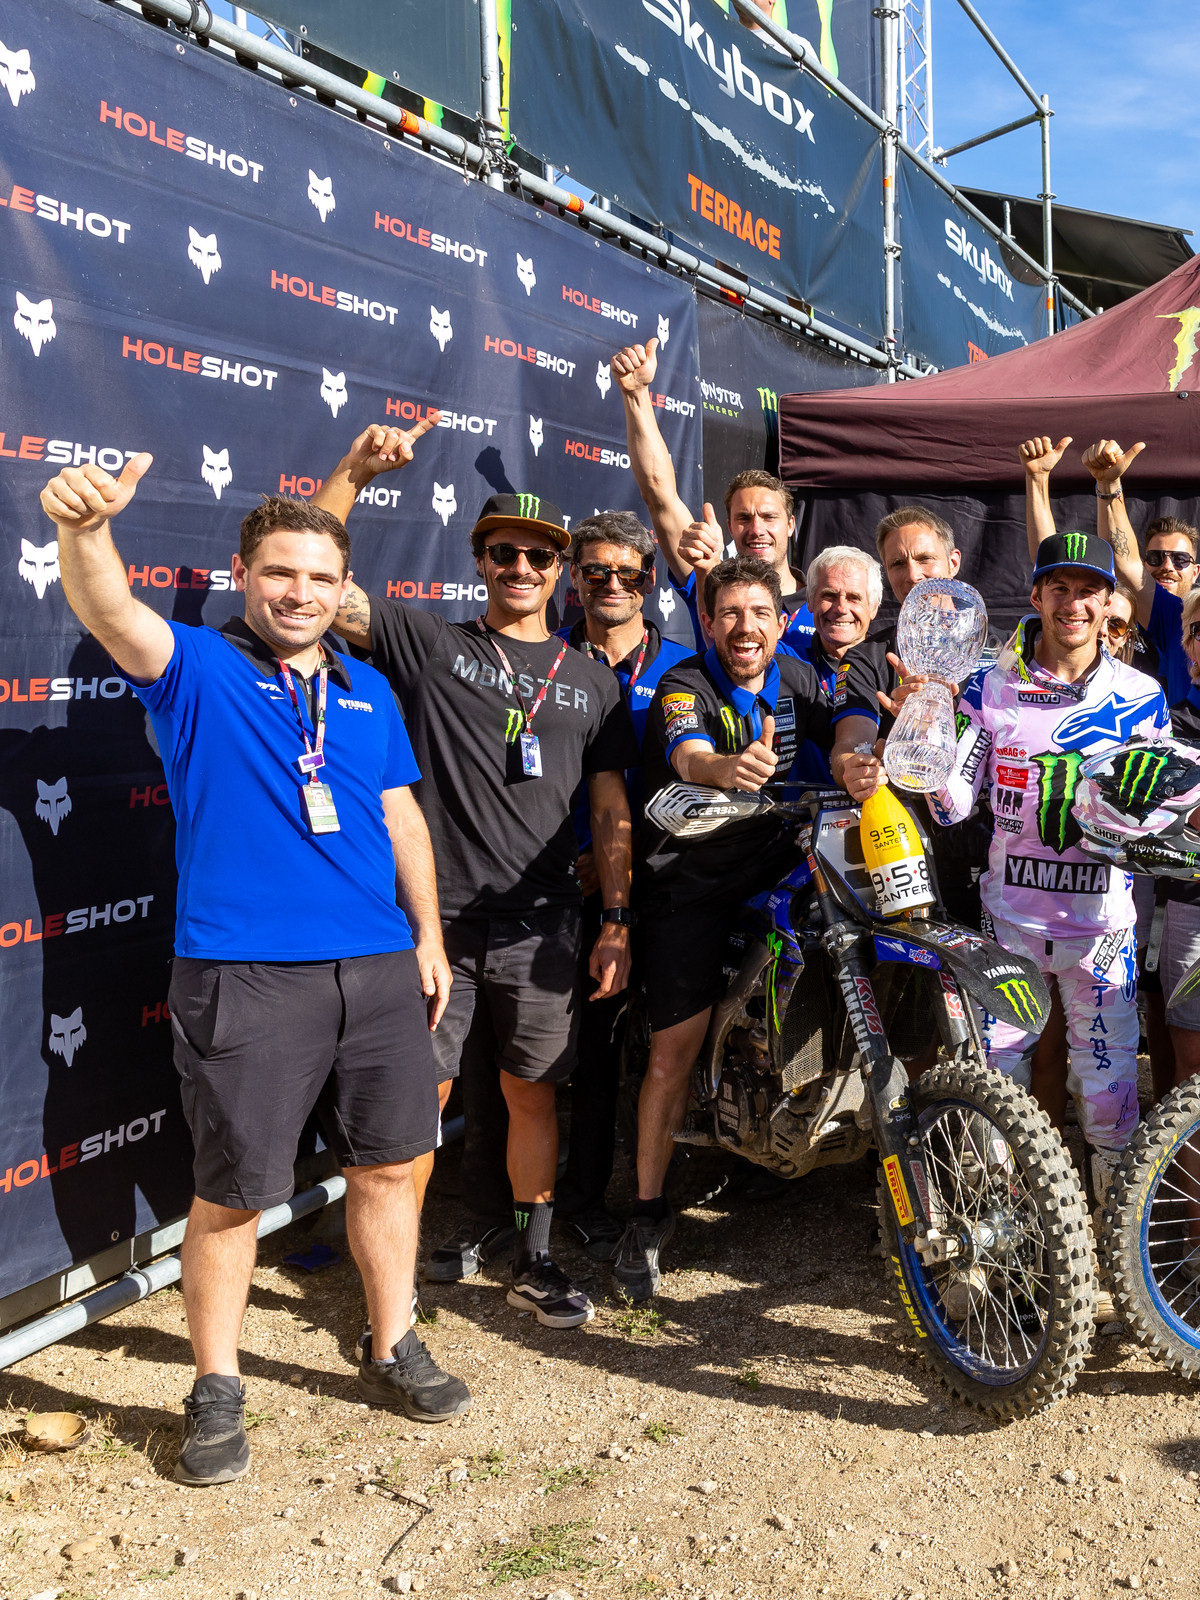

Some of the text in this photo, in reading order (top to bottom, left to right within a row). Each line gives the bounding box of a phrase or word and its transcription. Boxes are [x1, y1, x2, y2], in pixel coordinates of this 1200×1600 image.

[100, 100, 264, 183] HOLESHOT
[0, 184, 131, 244] ESHOT
[688, 173, 781, 260] TERRACE
[374, 211, 488, 267] HOLESHOT
[944, 218, 1014, 303] Skybox
[270, 269, 399, 325] HOLESHOT
[562, 285, 639, 329] HOLESHOT
[122, 336, 278, 391] HOLESHOT
[484, 335, 576, 379] HOLESHOT
[650, 391, 696, 419] LESHOT
[700, 379, 744, 409] ONSTER
[703, 401, 739, 418] ENERGY
[565, 439, 631, 468] HOLESHO
[128, 565, 236, 591] HOLES
[387, 580, 489, 602] HOLESHO
[452, 655, 589, 713] MONSTER
[1020, 694, 1060, 703] WILVO
[686, 806, 738, 817] ACERBIS
[1095, 828, 1121, 842] SHOEI
[1008, 857, 1107, 892] YAMAHA
[0, 895, 154, 949] OLESHOT
[910, 950, 932, 963] VERTEX
[983, 965, 1025, 979] YAMAHA
[838, 966, 872, 1053] YAMAHA
[854, 977, 884, 1035] KYB
[887, 1162, 909, 1219] PIRELLI
[891, 1255, 927, 1338] PIRELLI
